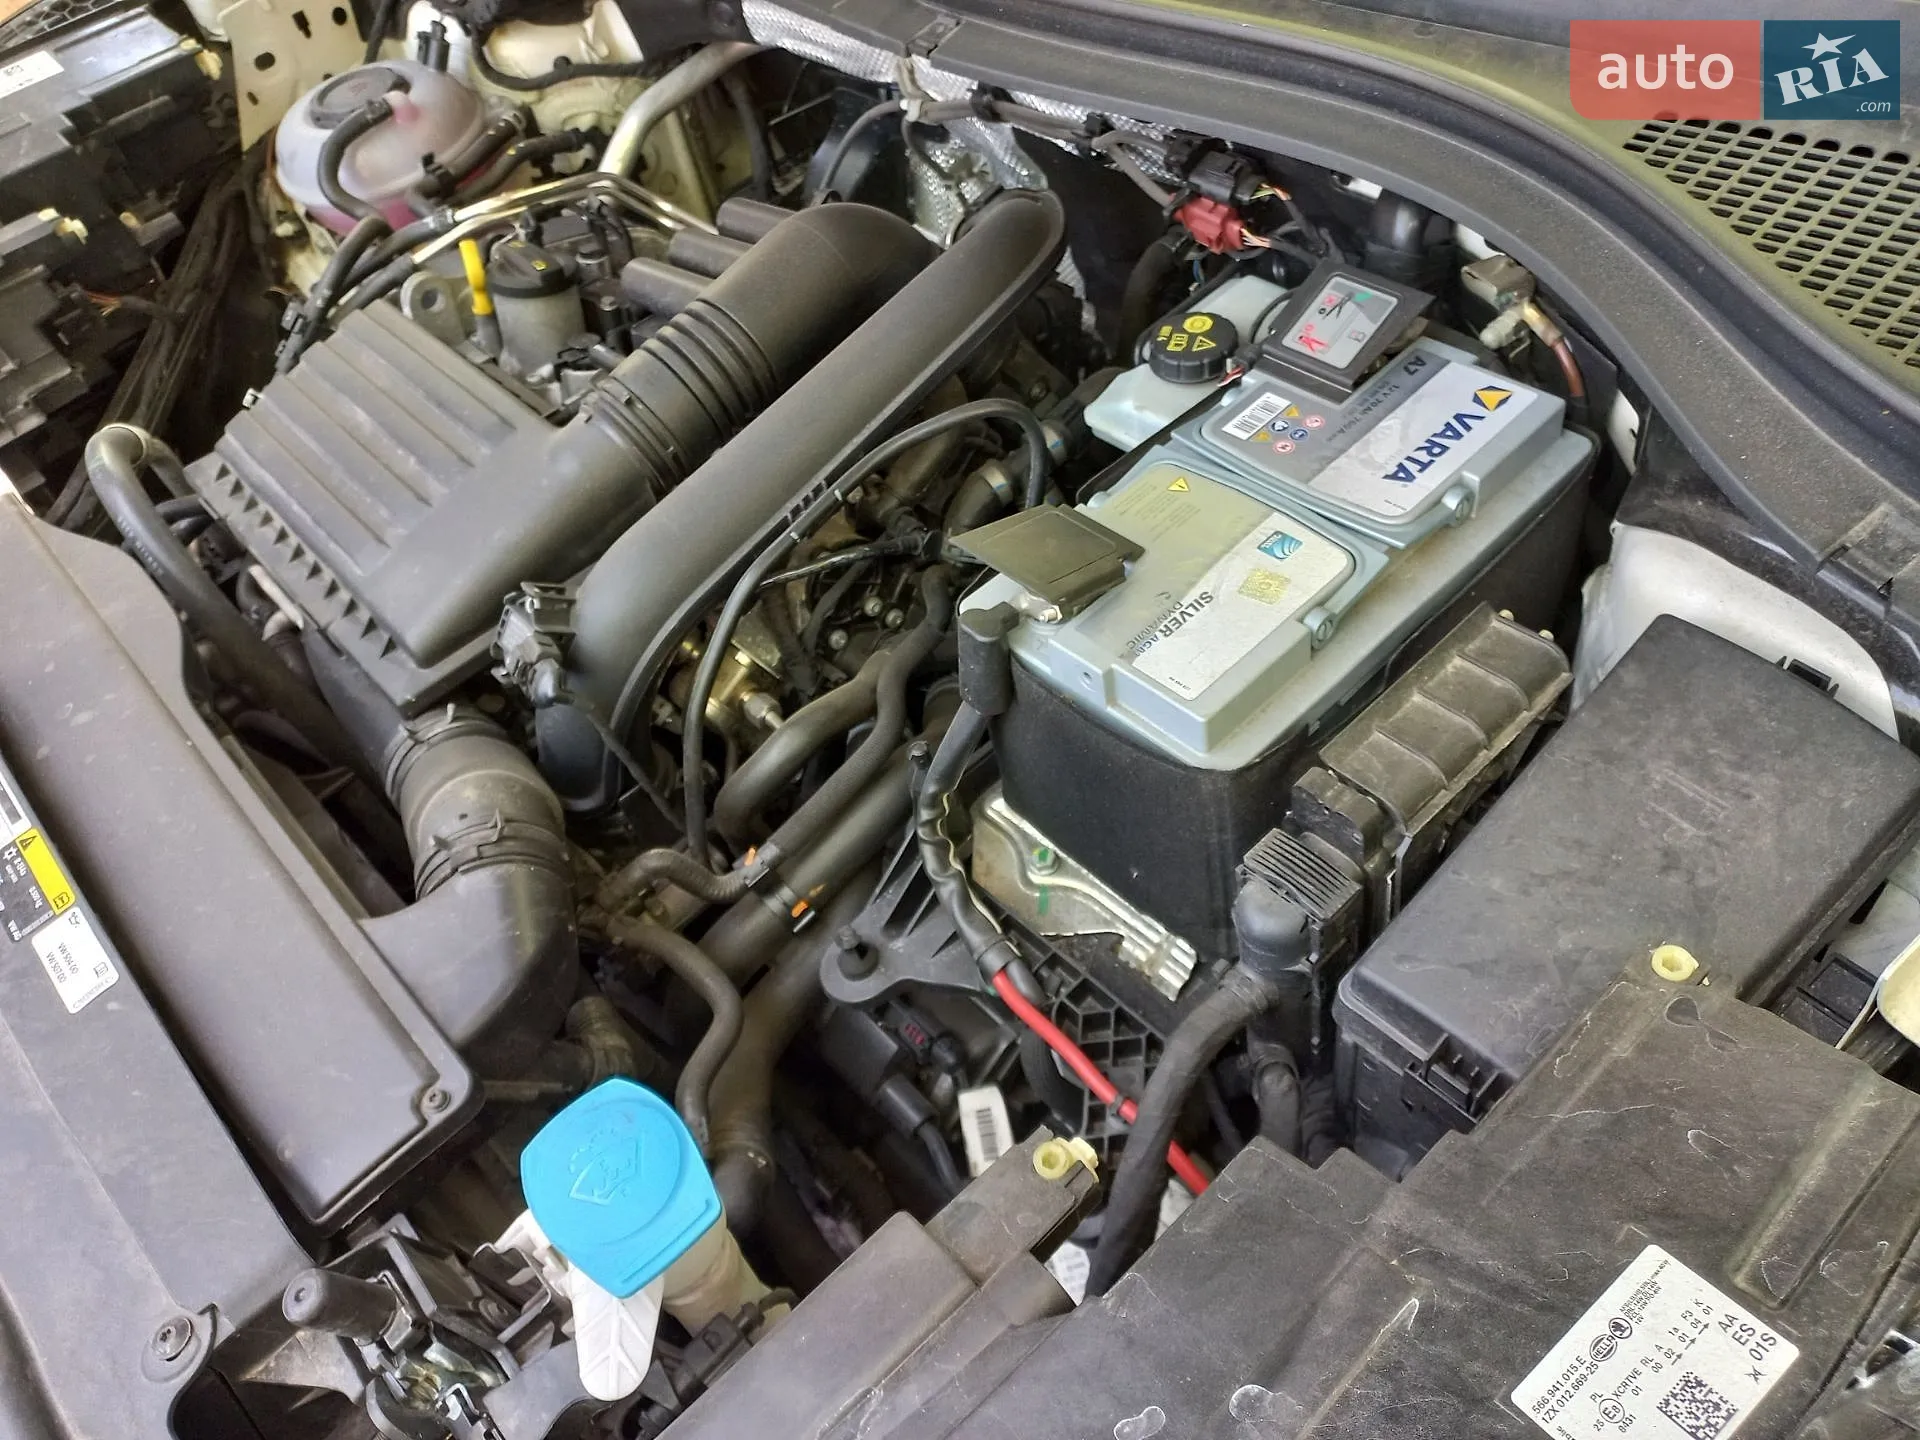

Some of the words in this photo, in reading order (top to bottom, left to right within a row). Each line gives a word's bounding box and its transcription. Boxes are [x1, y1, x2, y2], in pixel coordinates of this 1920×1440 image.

[1403, 355, 1427, 376] A7
[1382, 413, 1486, 483] VARTA
[1126, 600, 1184, 650] DYNAMIC
[1159, 591, 1214, 638] SILVER
[46, 952, 55, 964] VW
[58, 943, 68, 955] VW
[1718, 1313, 1740, 1334] AA
[1731, 1323, 1756, 1347] ES
[1592, 1334, 1616, 1359] HELLA
[1612, 1367, 1643, 1400] XCRTVE
[1640, 1356, 1655, 1367] RL
[1654, 1343, 1665, 1352] A
[1668, 1327, 1680, 1337] 1a
[1680, 1310, 1694, 1322] F3
[1693, 1298, 1704, 1308] K
[1631, 1385, 1643, 1397] 01
[1651, 1362, 1663, 1374] 00
[1663, 1347, 1676, 1359] 02
[1677, 1332, 1690, 1343] 01
[1690, 1317, 1703, 1329] 04
[1702, 1305, 1714, 1316] 01
[1748, 1332, 1777, 1361] 01S
[1531, 1355, 1587, 1414] 566.941.015.E
[1541, 1404, 1560, 1424] 1ZX
[1556, 1360, 1599, 1408] 012.669-25
[1589, 1392, 1604, 1404] PL
[1593, 1418, 1605, 1432] 25
[1602, 1404, 1621, 1421] E8
